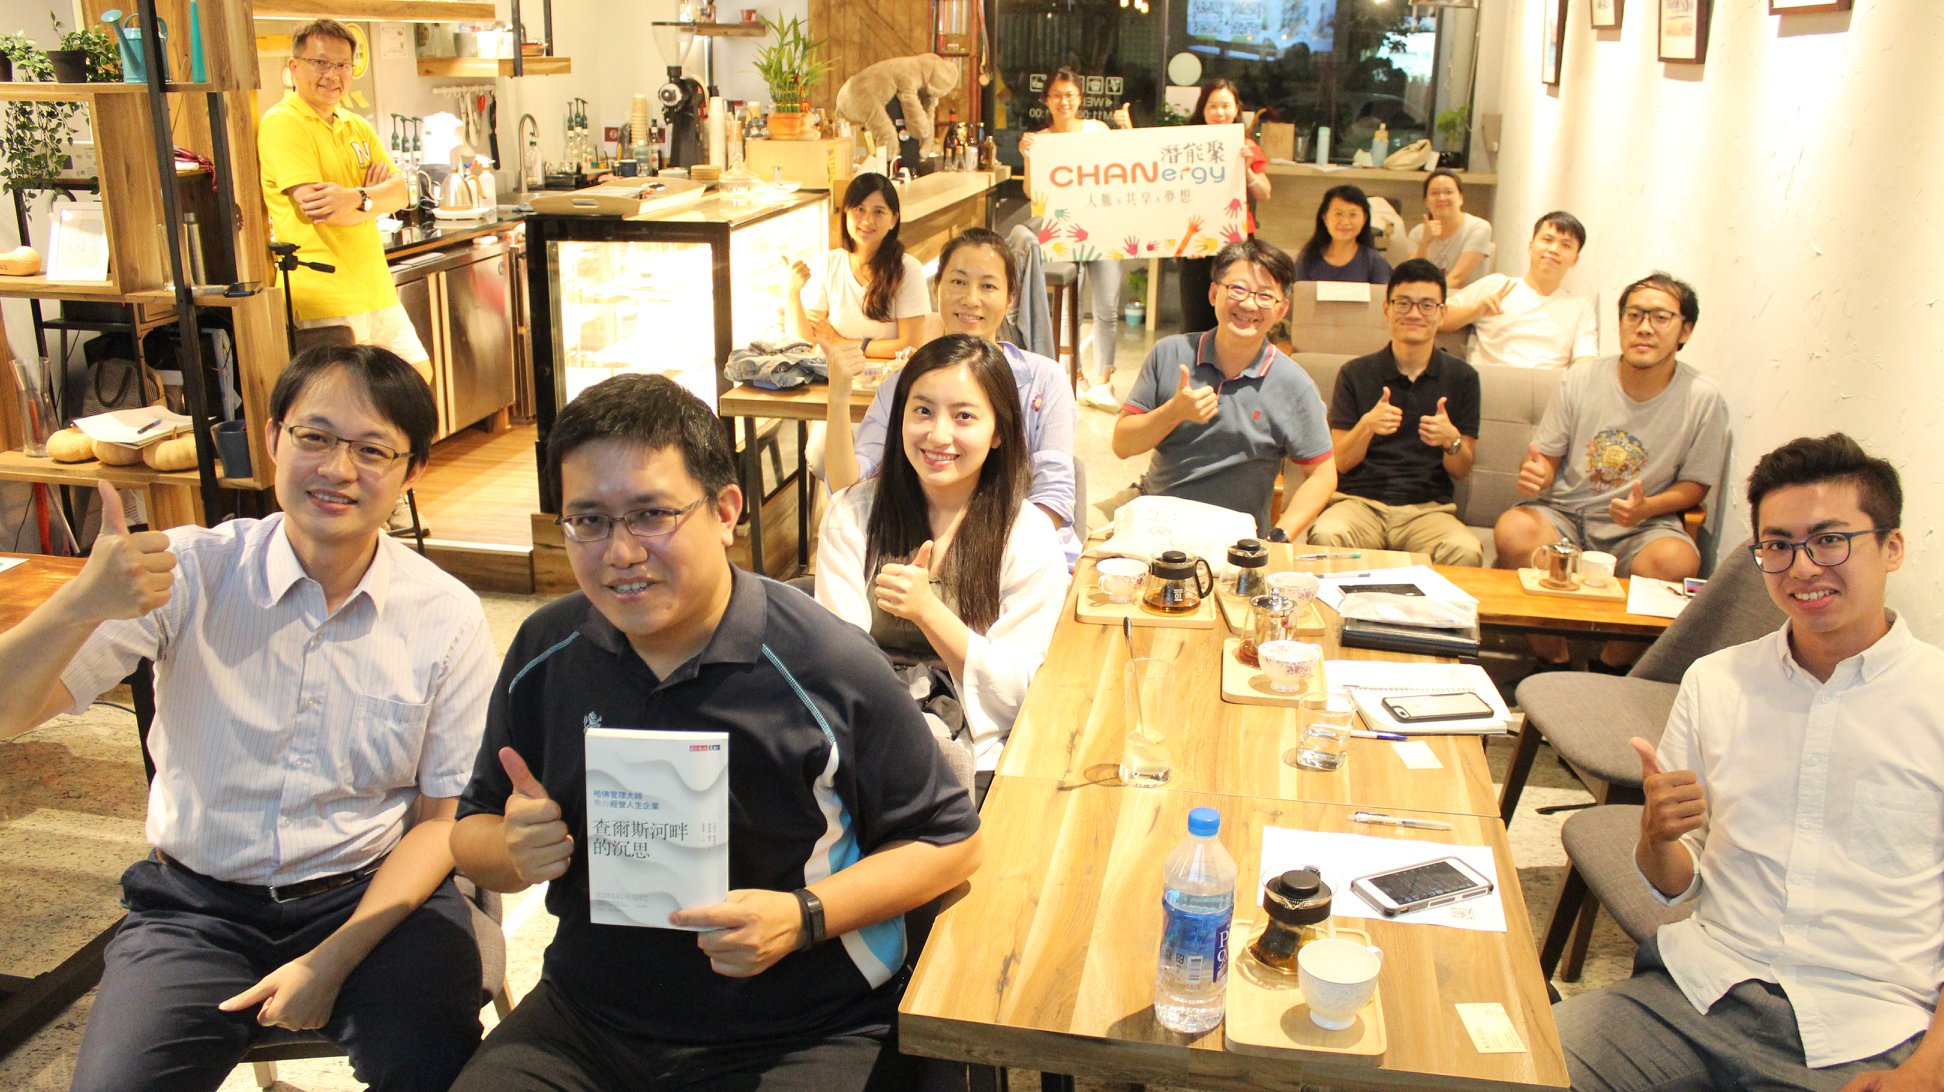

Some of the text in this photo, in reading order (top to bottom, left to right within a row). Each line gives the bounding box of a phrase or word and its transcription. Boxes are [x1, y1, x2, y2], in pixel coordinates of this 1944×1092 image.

[351, 141, 371, 165] N
[1161, 140, 1225, 164] 潛能聚
[1049, 161, 1226, 188] CHANergy
[593, 818, 688, 841] 查爾斯河畔
[593, 838, 650, 859] 的沉思
